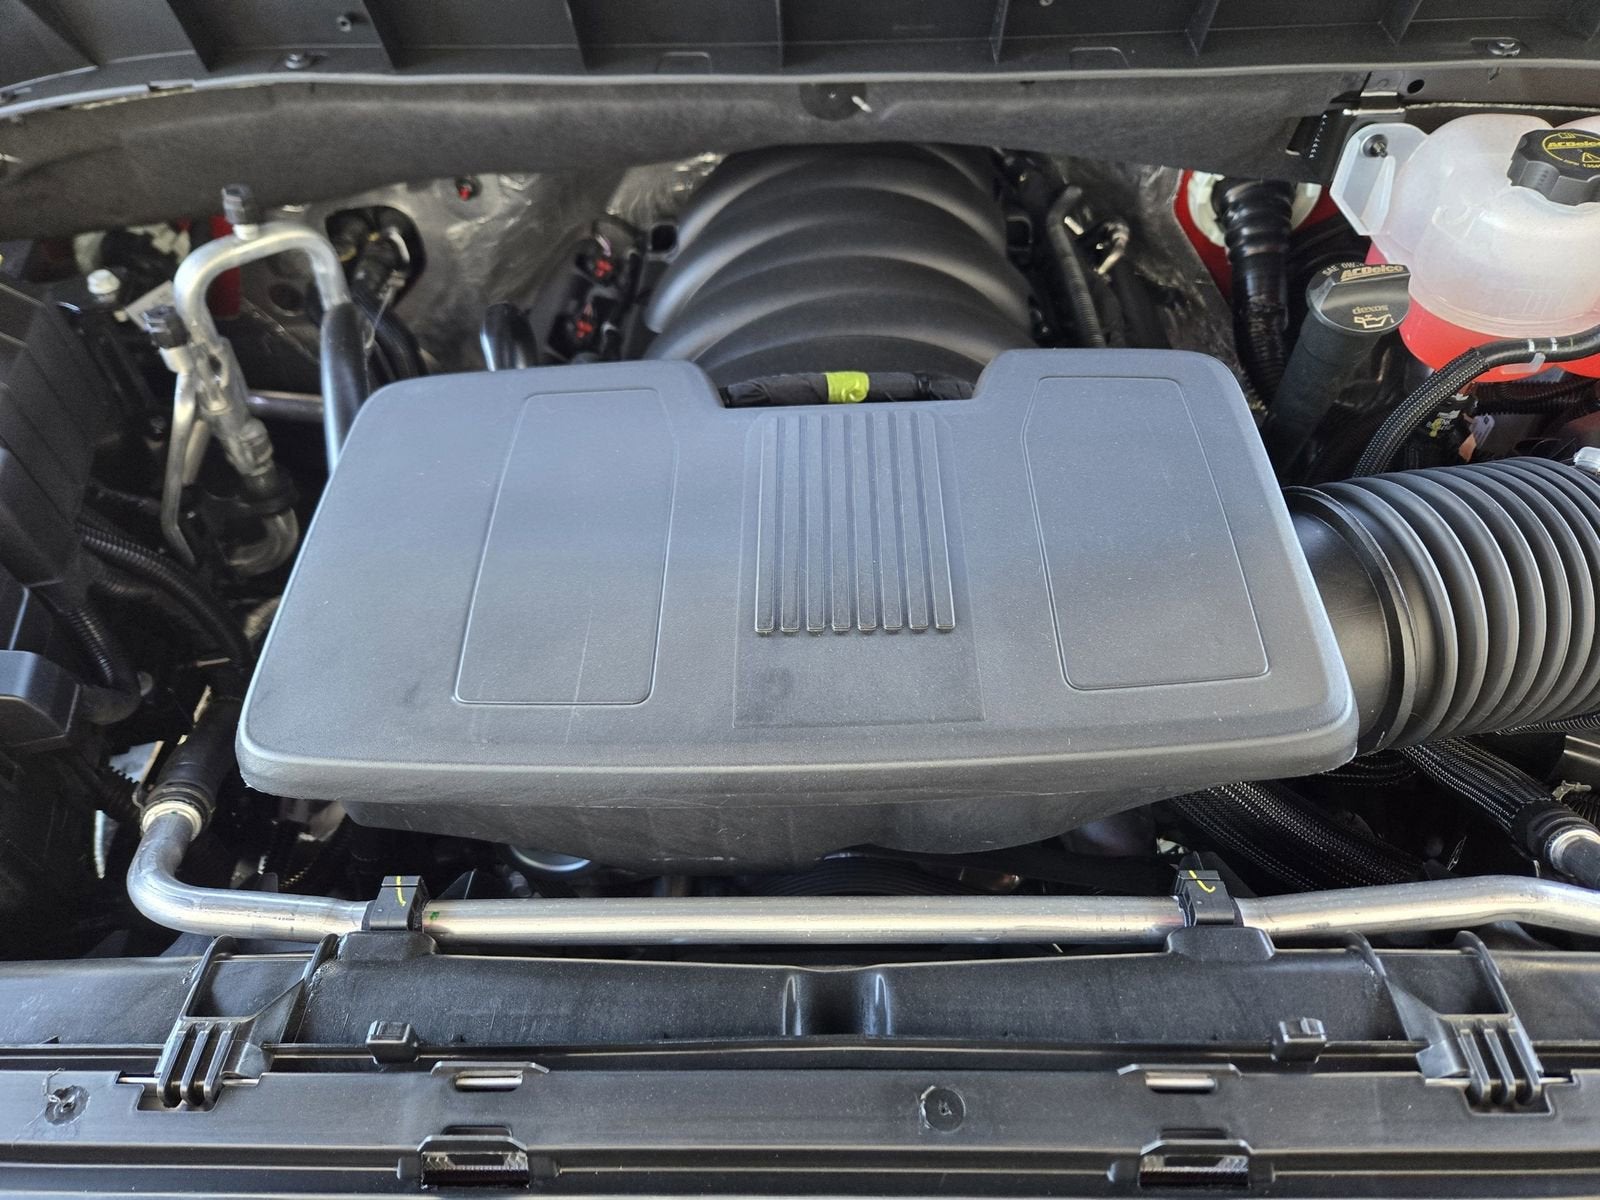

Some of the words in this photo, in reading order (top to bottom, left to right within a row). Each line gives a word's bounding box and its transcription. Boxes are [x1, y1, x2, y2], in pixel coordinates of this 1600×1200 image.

[1322, 265, 1340, 276] SAE
[1340, 265, 1404, 281] ACDelco
[1352, 305, 1389, 315] dexos
